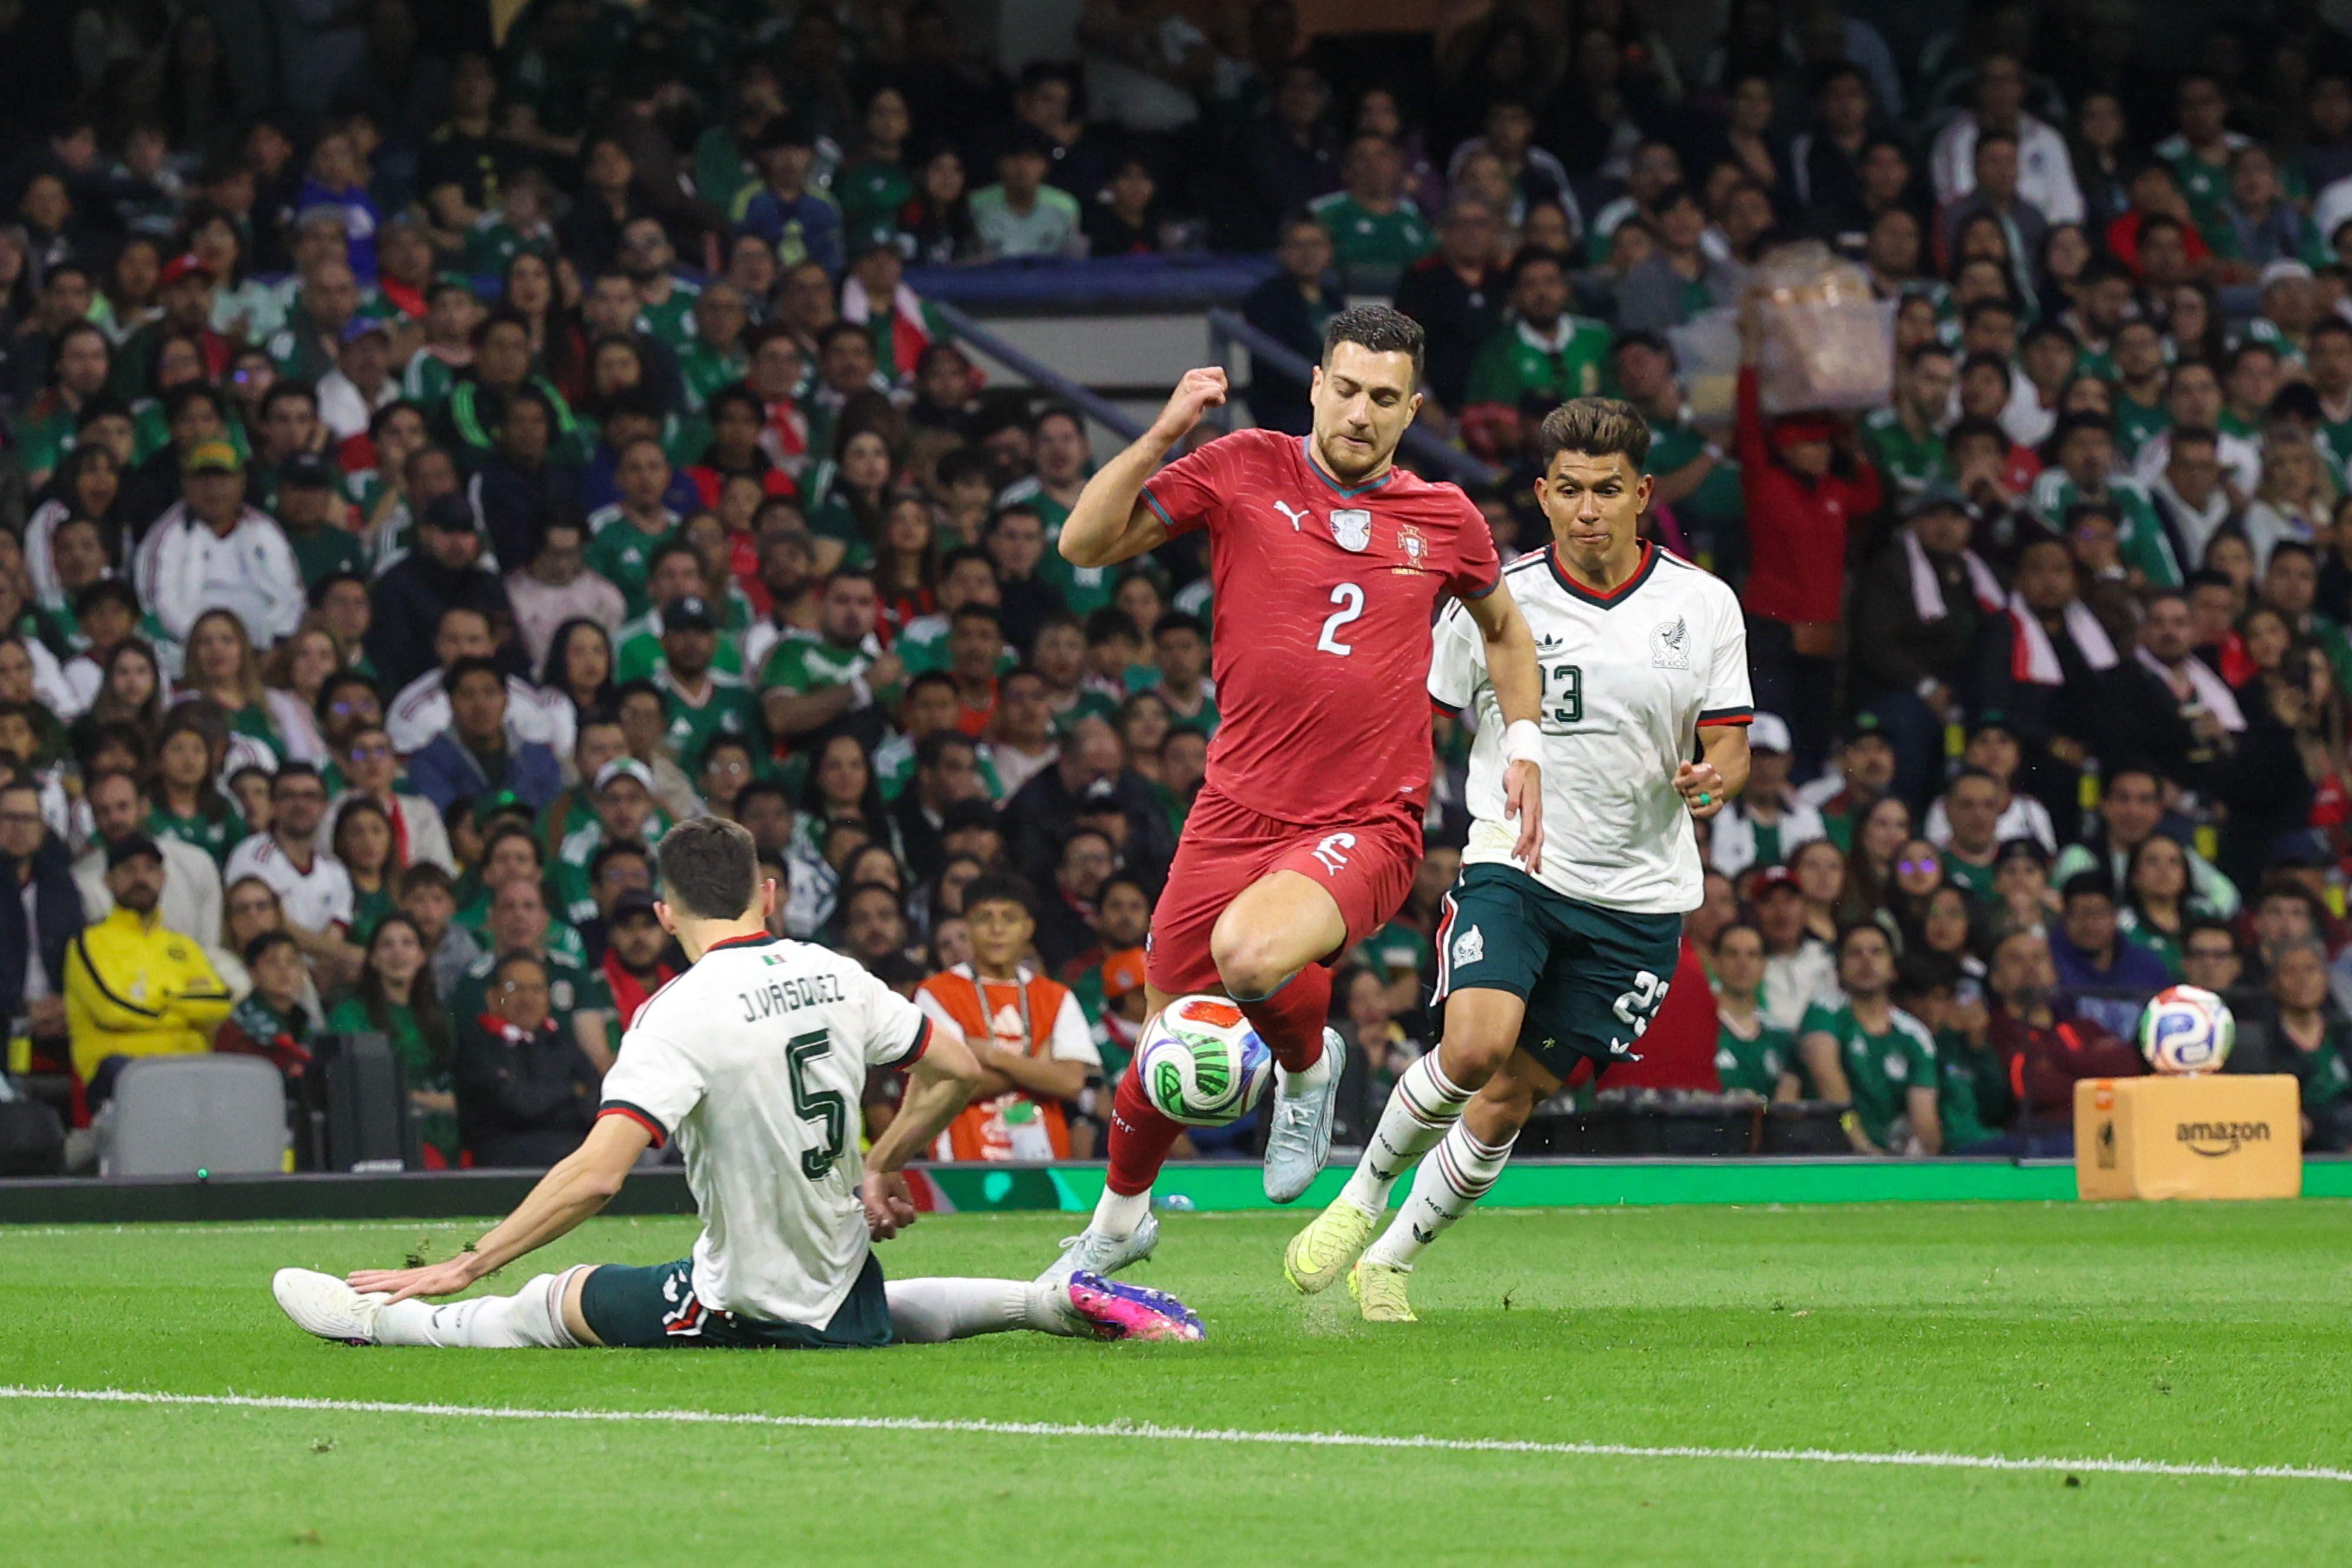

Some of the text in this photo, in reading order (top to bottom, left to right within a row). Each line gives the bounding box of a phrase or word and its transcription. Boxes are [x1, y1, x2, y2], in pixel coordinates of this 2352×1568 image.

[1317, 583, 1365, 656] 2
[1655, 659, 1688, 668] MEXICO
[786, 1027, 846, 1182] 5
[2177, 1121, 2271, 1142] amazon
